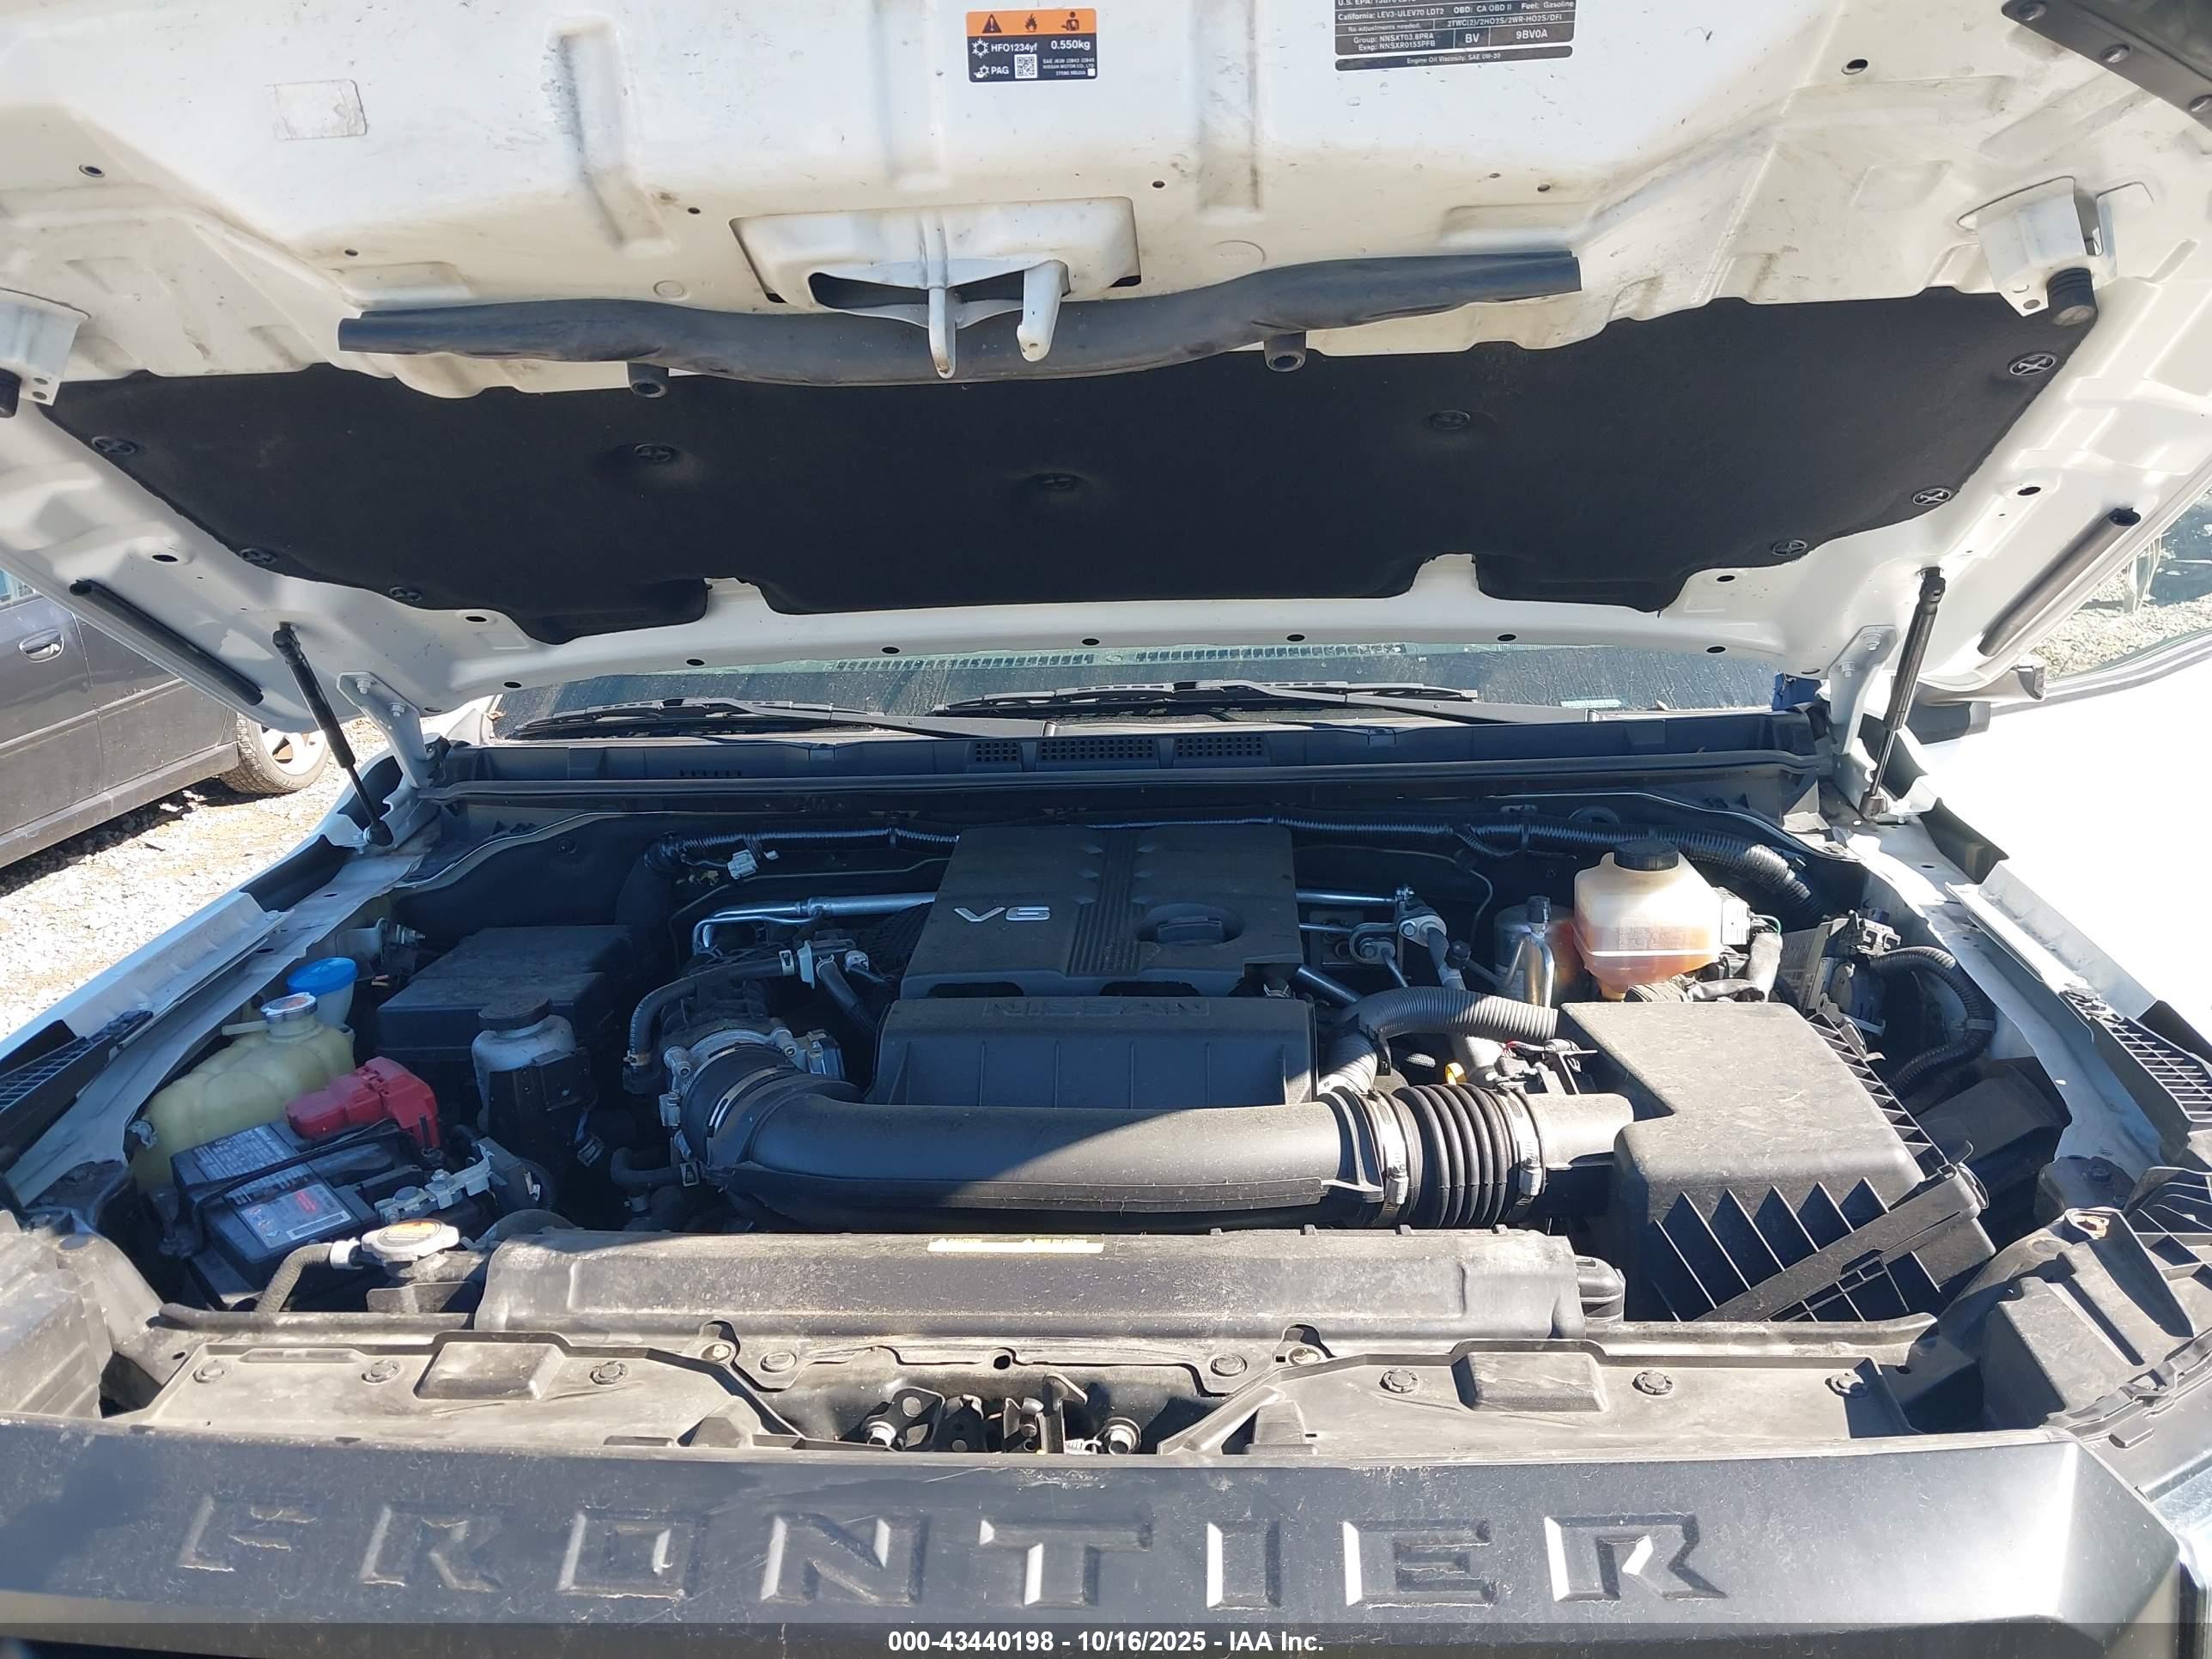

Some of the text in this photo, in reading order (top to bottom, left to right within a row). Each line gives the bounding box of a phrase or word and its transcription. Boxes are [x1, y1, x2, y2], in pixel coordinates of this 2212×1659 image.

[1522, 0, 1574, 10] Fuel: Gasoline
[1338, 12, 1376, 21] California:
[1377, 9, 1425, 19] LEV3-ULEV70
[1358, 24, 1395, 33] adjustments
[1353, 36, 1377, 45] Group:
[1465, 33, 1480, 43] BV
[1050, 40, 1091, 51] 0.550kg
[1358, 44, 1377, 52] Evap:
[991, 65, 1010, 75] PAG
[953, 906, 1051, 922] V6
[982, 1000, 1209, 1017] NISSAN
[178, 1492, 1729, 1609] FRONTIER
